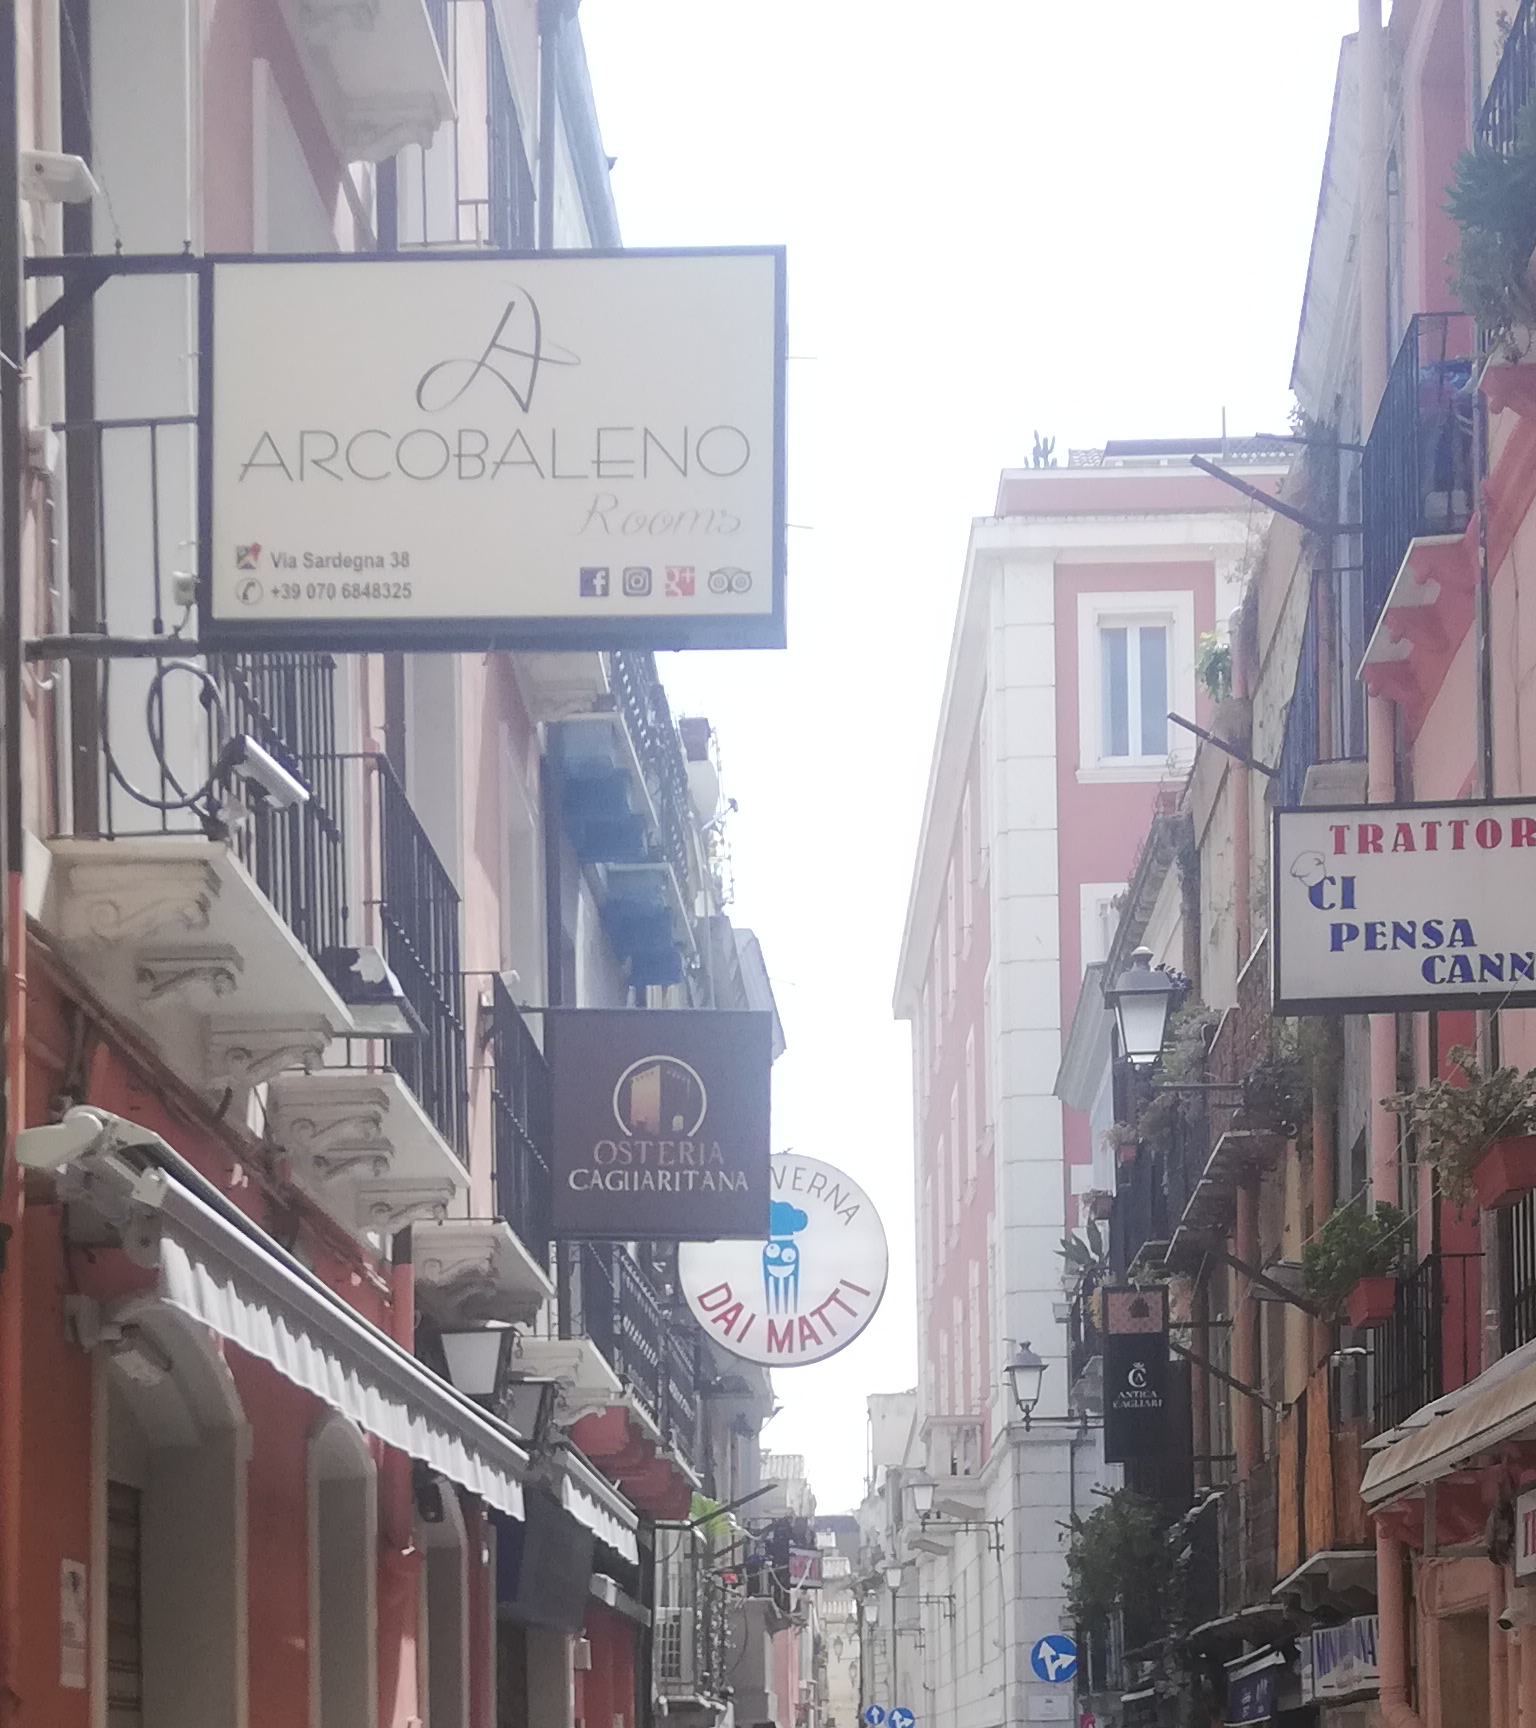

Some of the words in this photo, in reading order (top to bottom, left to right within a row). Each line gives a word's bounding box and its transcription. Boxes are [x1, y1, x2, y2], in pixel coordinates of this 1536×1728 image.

[238, 425, 751, 482] ARCOBALENO
[576, 491, 742, 536] Rooms
[270, 552, 297, 569] Via
[303, 552, 384, 571] Sardegna
[390, 551, 410, 568] 38
[271, 583, 301, 600] +39
[306, 583, 336, 600] 070
[342, 582, 412, 600] 6848325
[1309, 875, 1356, 910] CI
[1329, 919, 1477, 952] PENSA
[593, 1140, 724, 1165] OSTERIA
[770, 1165, 860, 1226] VERNA
[697, 1282, 756, 1343] DAI
[767, 1279, 871, 1353] MATTI
[1112, 1399, 1162, 1408] CAGLIARI
[1117, 1390, 1158, 1399] ANTICA
